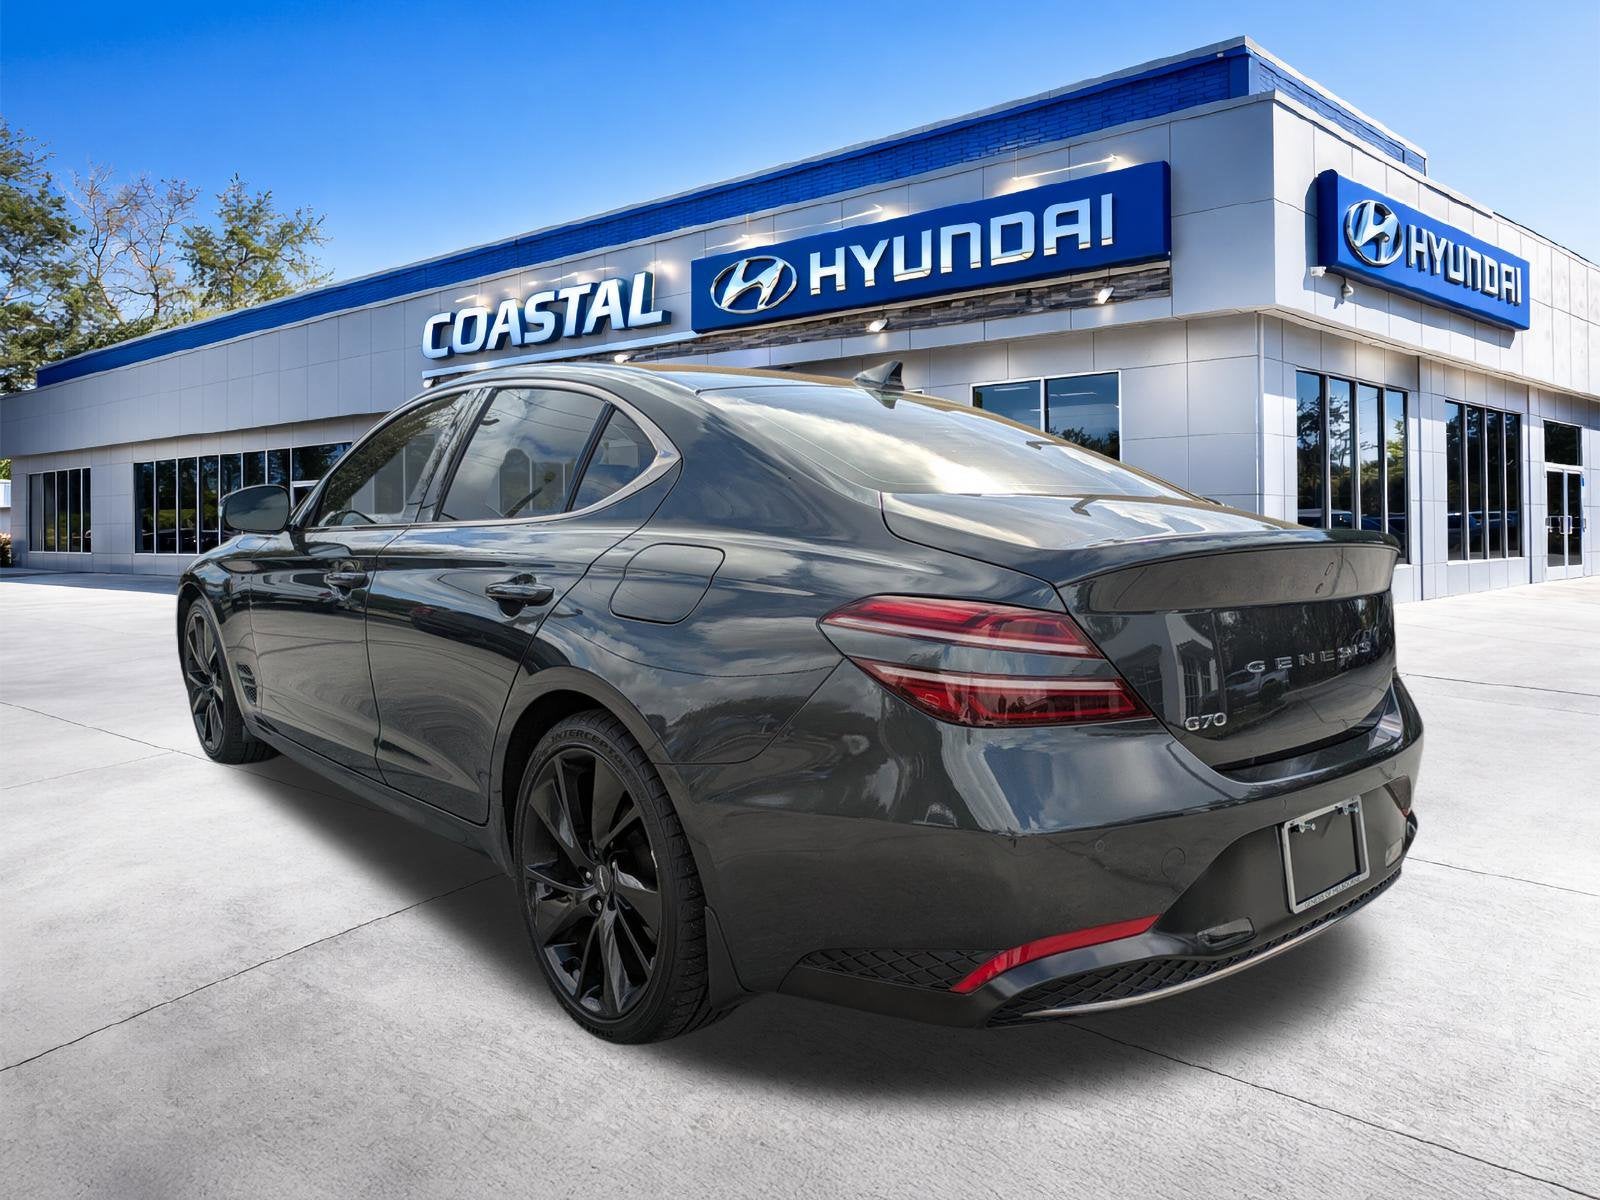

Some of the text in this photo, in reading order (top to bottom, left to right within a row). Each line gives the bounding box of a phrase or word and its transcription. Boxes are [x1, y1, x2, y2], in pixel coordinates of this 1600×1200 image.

[810, 193, 1113, 296] HYUNDAI
[1406, 224, 1521, 306] HYUNDAI
[422, 271, 671, 359] COASTAL
[1246, 640, 1372, 673] GENESIS
[1184, 712, 1227, 731] G70
